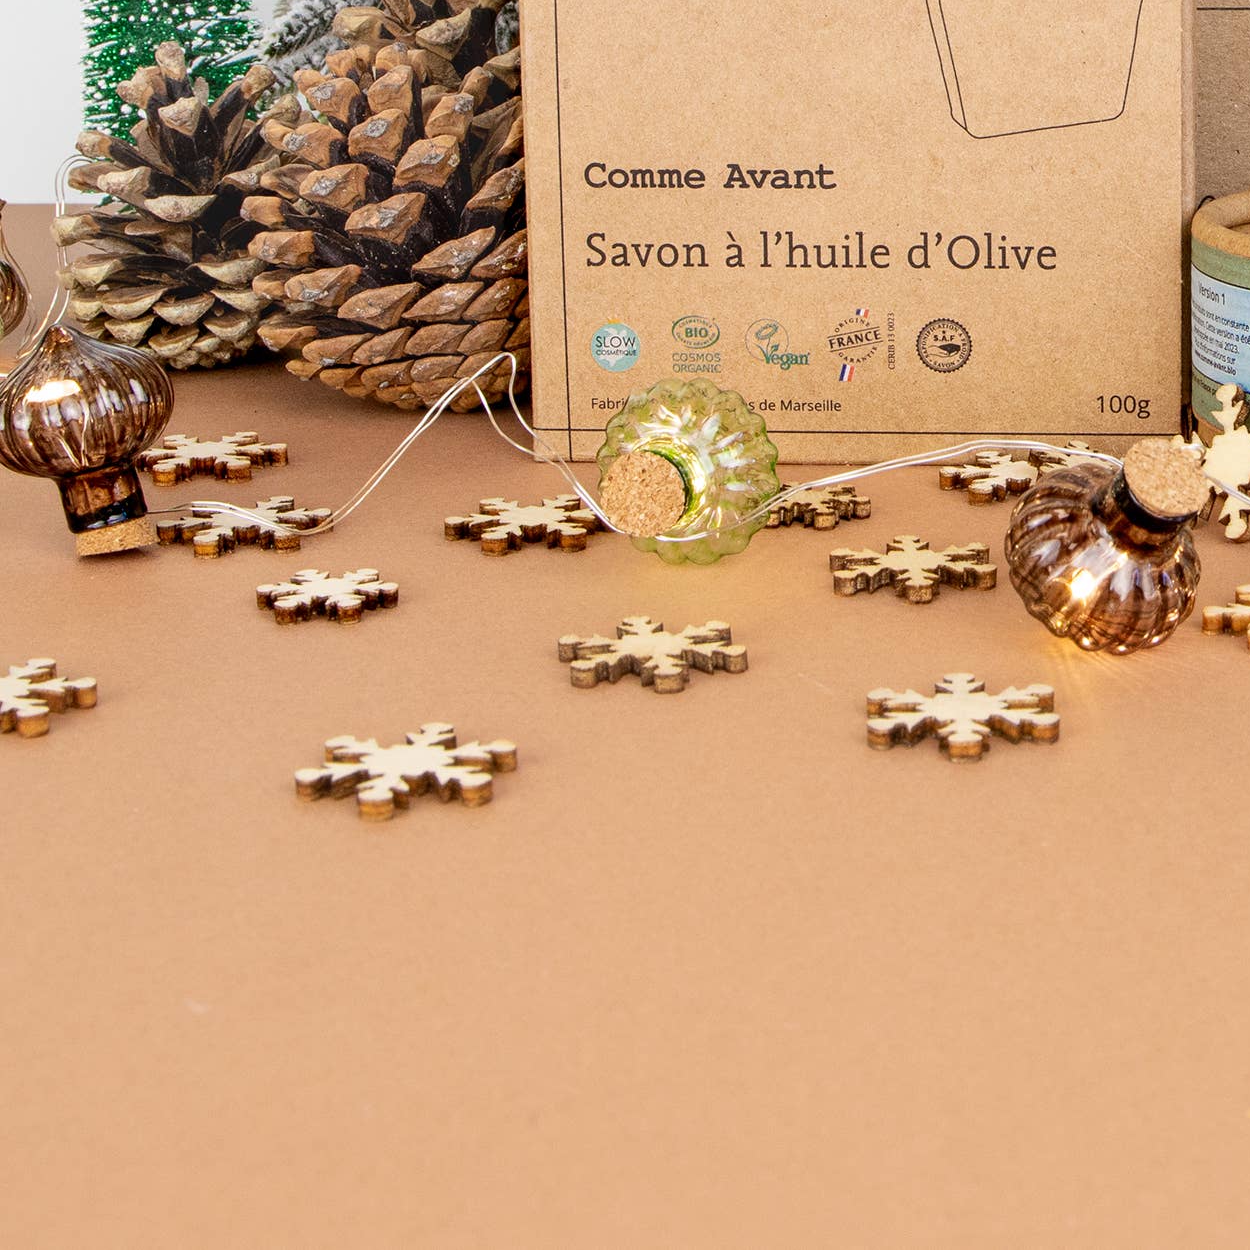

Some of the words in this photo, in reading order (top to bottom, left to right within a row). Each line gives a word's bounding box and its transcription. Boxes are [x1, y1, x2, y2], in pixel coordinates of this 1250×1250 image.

[583, 162, 706, 190] Comme
[723, 162, 837, 190] Avant
[586, 232, 710, 268] Savon
[725, 230, 746, 268] à
[759, 230, 890, 269] l’huile
[907, 231, 1057, 271] d’Olive
[887, 312, 896, 332] 0023
[595, 335, 636, 349] SLOW
[685, 327, 709, 339] BIO
[828, 329, 882, 350] FRANCE
[672, 352, 722, 363] COSMOS
[757, 344, 809, 370] Vegan
[887, 345, 896, 371] CERIB
[672, 363, 722, 374] ORGANIC
[759, 399, 776, 412] de
[780, 399, 842, 412] Marseille
[1096, 395, 1151, 420] 100g
